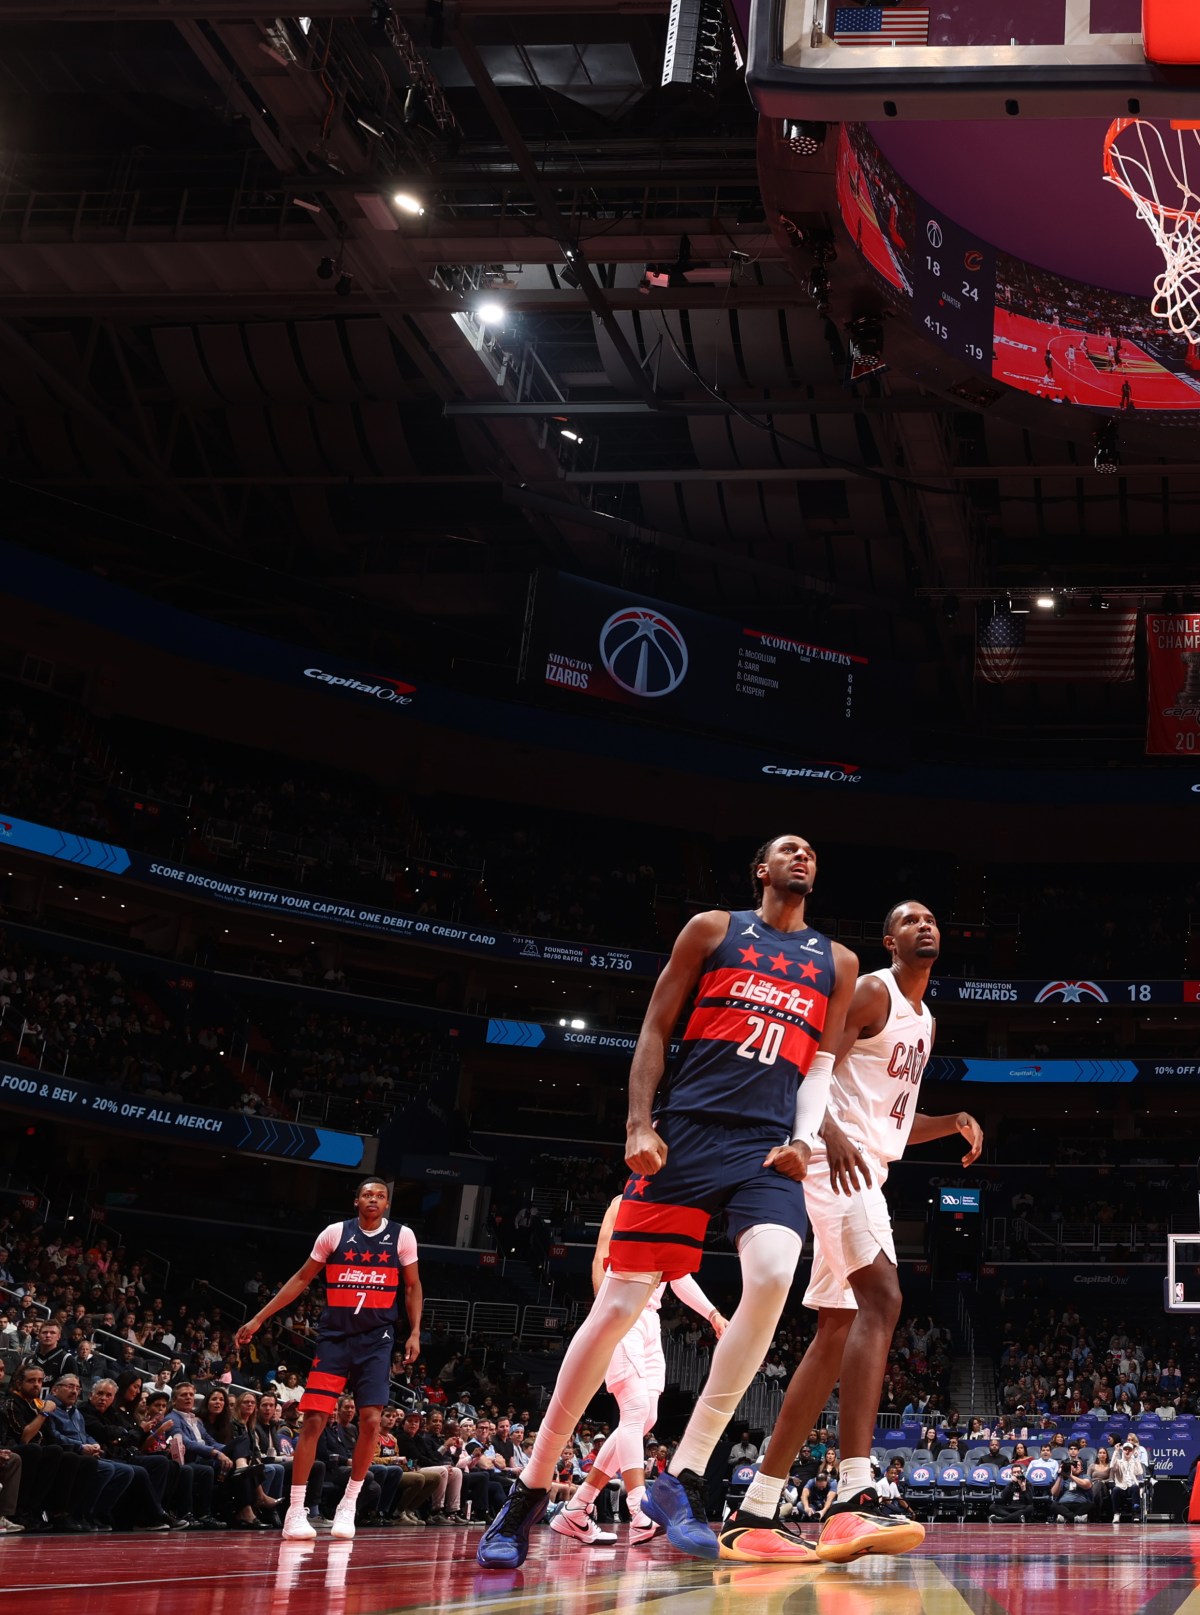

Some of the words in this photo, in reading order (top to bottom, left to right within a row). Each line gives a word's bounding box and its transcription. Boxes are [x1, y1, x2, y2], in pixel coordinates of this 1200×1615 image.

[925, 256, 941, 277] 18
[961, 281, 979, 302] 24
[941, 291, 962, 310] QUARTER
[923, 315, 948, 340] 4:15
[965, 344, 983, 360] :19
[760, 634, 804, 655] SCORING
[805, 645, 852, 666] LEADERS
[744, 661, 760, 672] SARR
[847, 673, 853, 683] 8
[743, 672, 779, 689] CARRINGTON
[846, 696, 852, 706] 3
[742, 684, 766, 698] KISPERT
[845, 708, 851, 718] 3
[149, 863, 186, 881] SCORE
[185, 873, 247, 897] DISCOUNTS
[248, 889, 278, 903] WITH
[280, 895, 311, 910] YOUR
[312, 902, 356, 918] CAPITAL
[358, 911, 382, 924] ONE
[382, 915, 413, 929] DEBIT
[415, 922, 430, 933] OR
[431, 925, 467, 940] CREDIT
[468, 933, 496, 946] CARD
[544, 946, 584, 956] FOUNDATION
[562, 954, 583, 963] RAFFLE
[589, 955, 633, 971] $3,730
[931, 988, 938, 997] 6
[965, 981, 1012, 990] WASHINGTON
[1127, 984, 1152, 1002] 18
[729, 974, 814, 1017] district
[958, 987, 1018, 1001] WIZARDS
[564, 1033, 598, 1044] SCORE
[736, 1015, 786, 1066] 20
[1154, 1066, 1174, 1075] 10%
[1176, 1066, 1195, 1075] OFF
[0, 1074, 38, 1094] FOOD
[38, 1086, 50, 1097] &
[51, 1086, 79, 1104] BEV
[92, 1096, 119, 1114] 20%
[120, 1103, 147, 1119] OFF
[147, 1109, 172, 1124] ALL
[174, 1113, 223, 1133] MERCH
[889, 1090, 910, 1130] 4
[482, 1255, 496, 1264] 108
[552, 1247, 565, 1256] 107
[338, 1268, 387, 1284] district
[915, 1264, 928, 1273] 107
[353, 1292, 367, 1315] 7
[545, 1319, 557, 1327] EXIT
[1152, 1448, 1186, 1457] ULTRA
